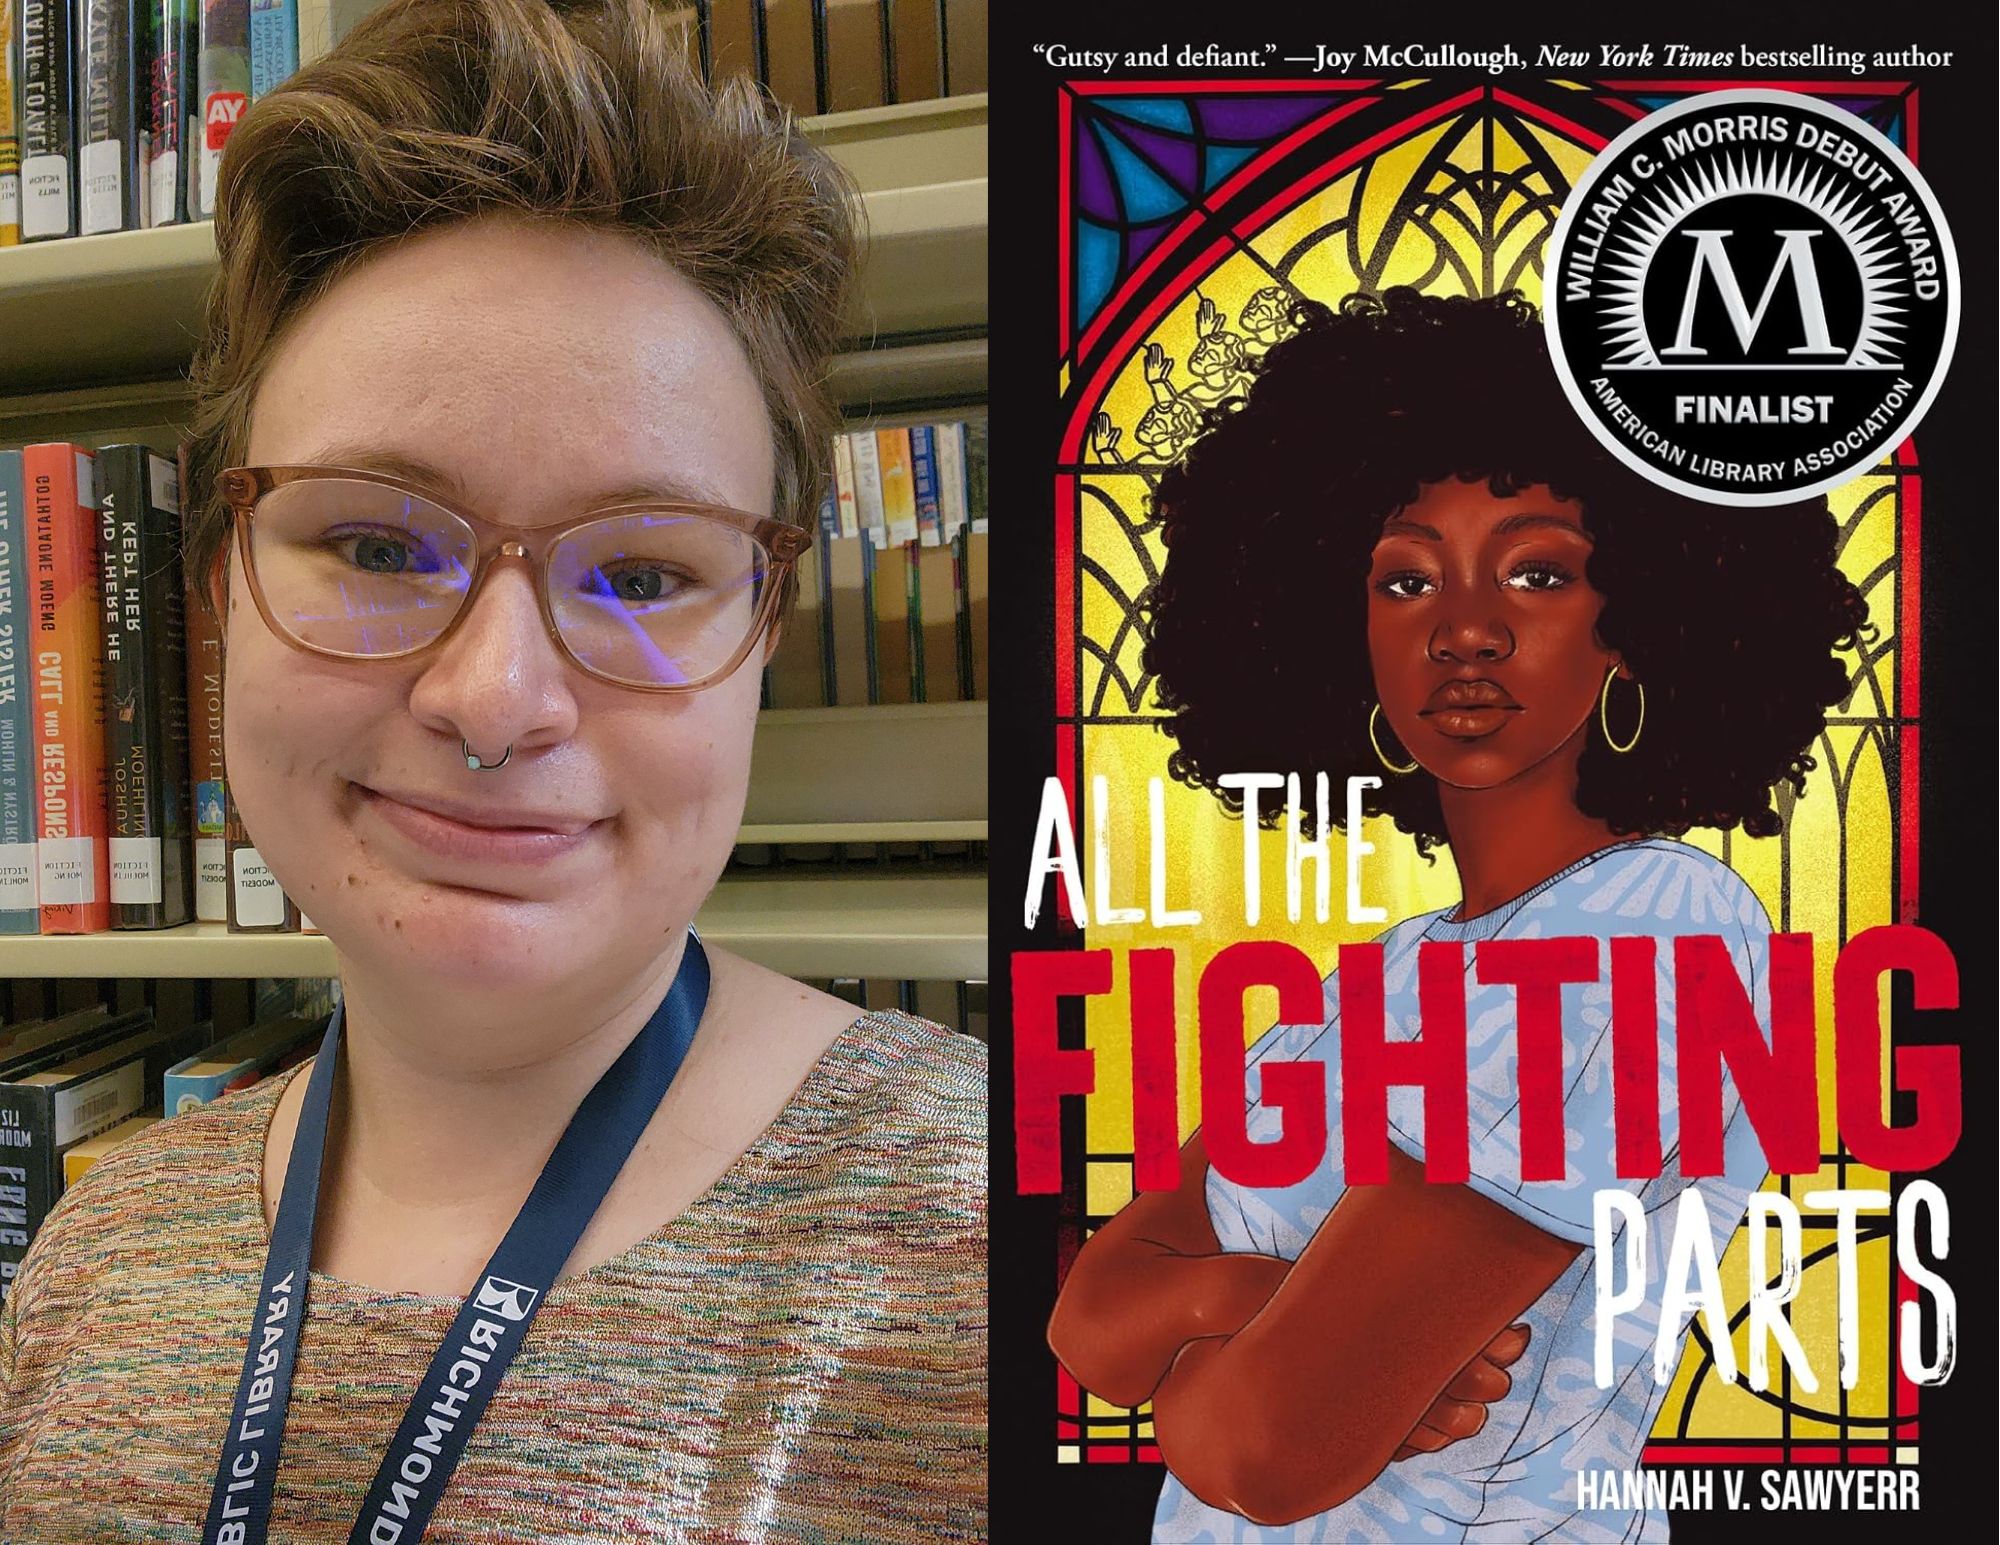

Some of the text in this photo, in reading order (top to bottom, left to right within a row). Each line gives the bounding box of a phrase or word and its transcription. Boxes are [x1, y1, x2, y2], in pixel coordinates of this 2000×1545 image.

[1032, 44, 1118, 74] “Gutsy
[1125, 43, 1169, 67] and
[1177, 43, 1277, 67] defiant.”
[1364, 43, 1527, 75] McCullough,
[1535, 44, 1590, 67] New
[1599, 43, 1654, 67] York
[1664, 44, 1735, 67] Times
[1741, 43, 1866, 75] bestselling
[1872, 43, 1954, 67] author
[1566, 115, 1940, 301] WILLIAM C. MORRIS DEBUT AWARD
[1660, 230, 1848, 355] M
[1590, 377, 1913, 482] AMERICAN LIBRARY ASSOCIATION
[1675, 395, 1834, 424] FINALIST
[1024, 771, 1389, 931] ALL THE
[1010, 925, 1962, 1197] FIGHTING
[1593, 1180, 1957, 1394] PARTS
[1576, 1469, 1920, 1511] HANNAH V. SAWYERR
